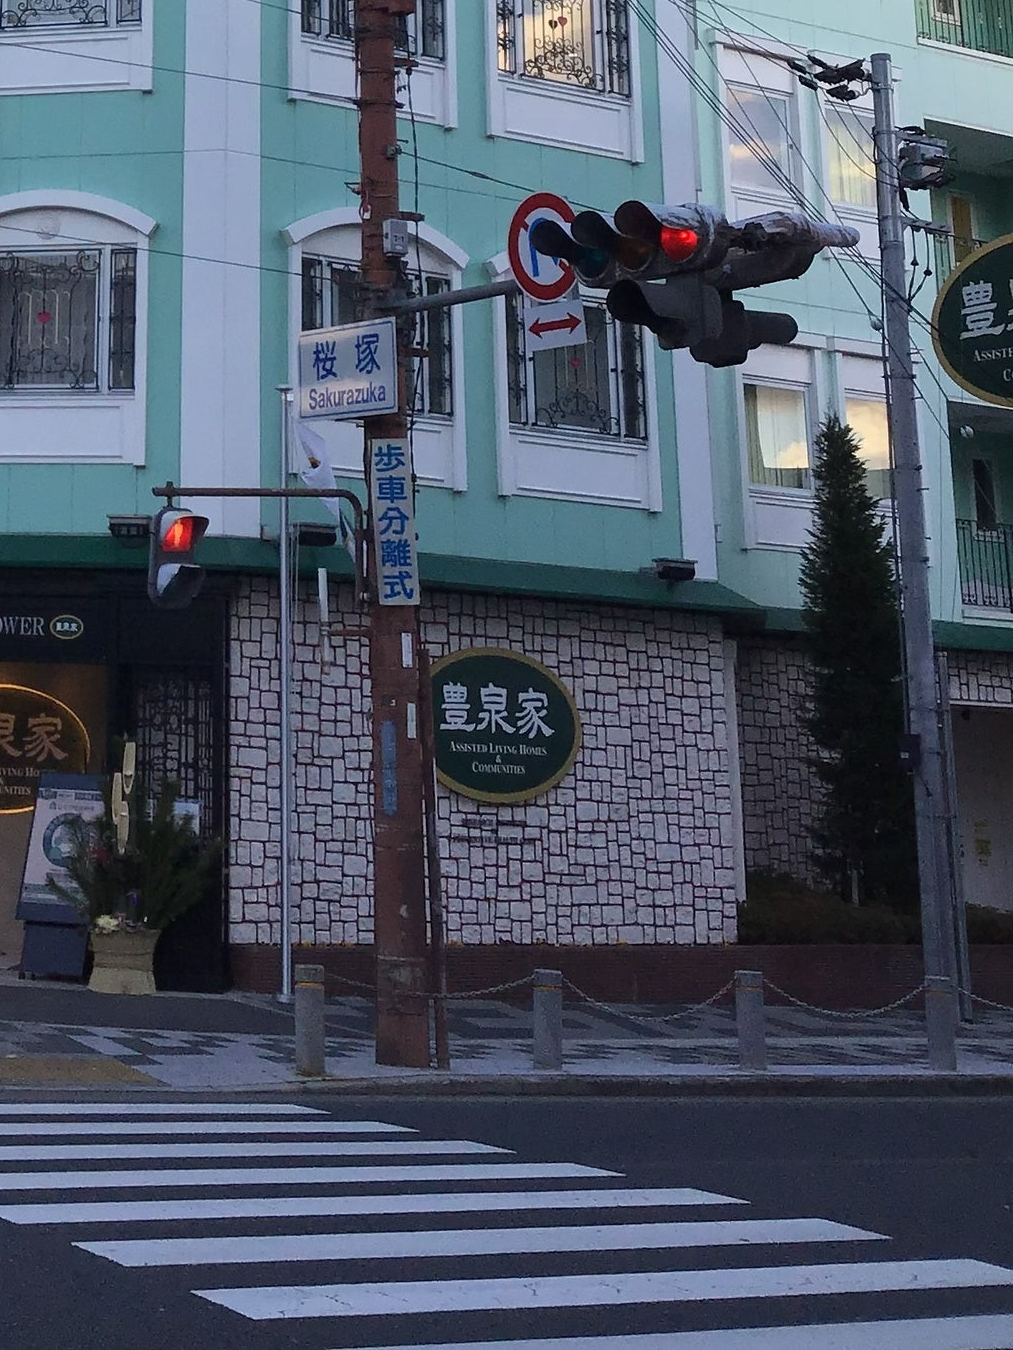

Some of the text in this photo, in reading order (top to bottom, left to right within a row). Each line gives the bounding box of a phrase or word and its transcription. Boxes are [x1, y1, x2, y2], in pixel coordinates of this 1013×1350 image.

[312, 333, 382, 382] 桜塚
[308, 382, 386, 411] Sakurazuka
[374, 443, 414, 601] 歩車分離式
[440, 681, 555, 738] 豊泉家
